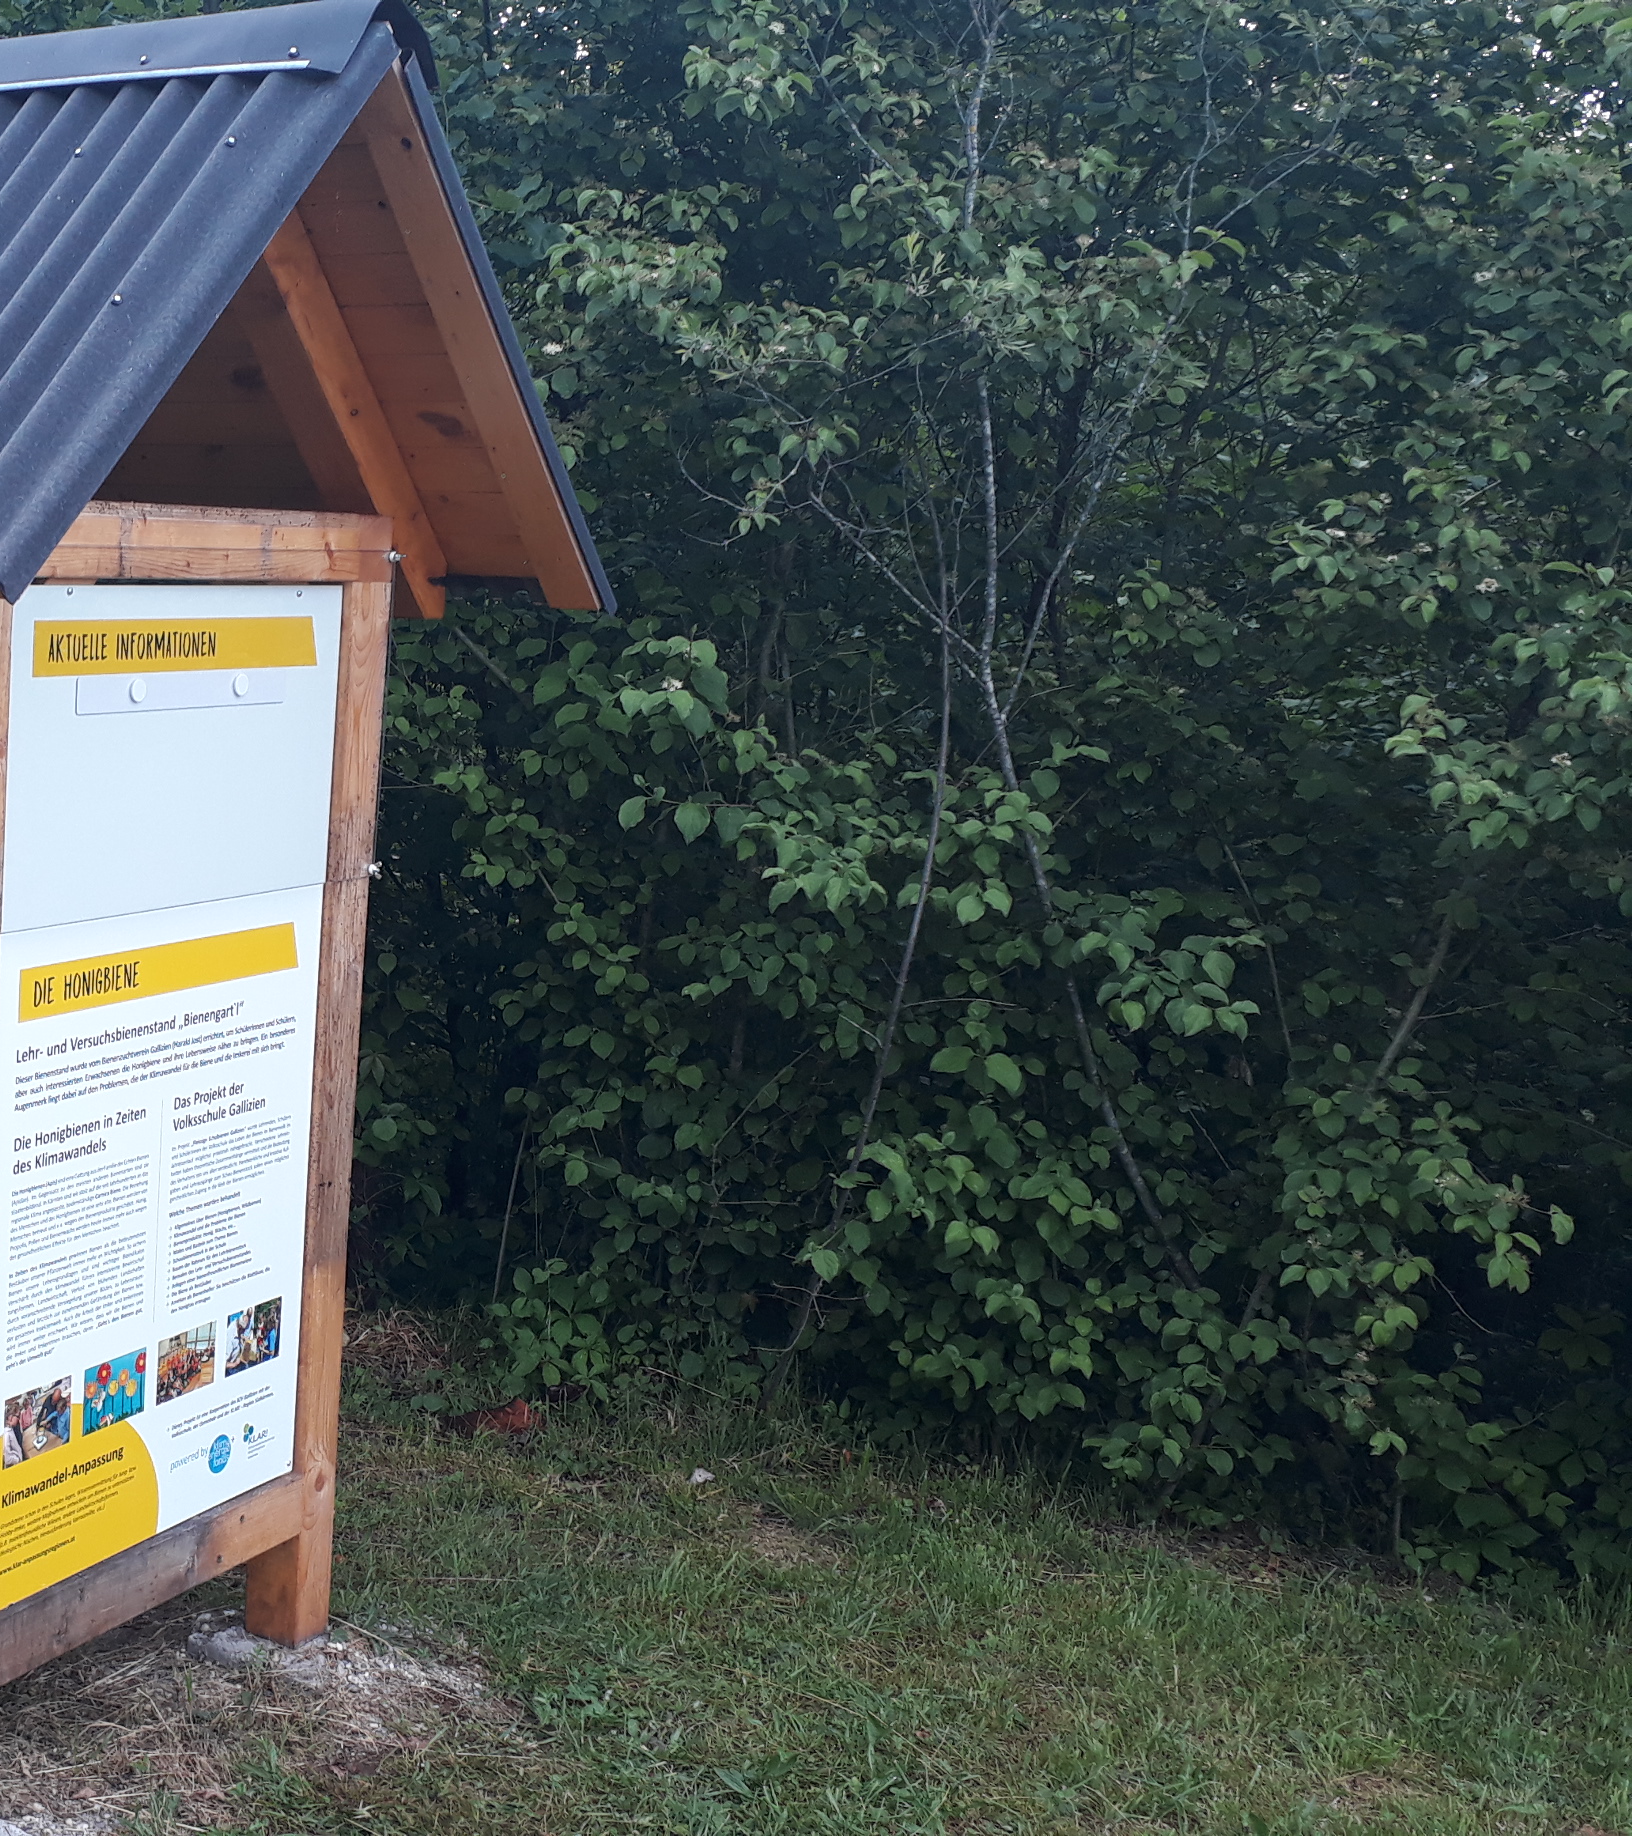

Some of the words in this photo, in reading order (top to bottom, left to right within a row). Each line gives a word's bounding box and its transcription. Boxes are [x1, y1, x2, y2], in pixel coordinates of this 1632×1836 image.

[47, 632, 108, 664] AKTUELLE
[116, 631, 217, 660] INFORMATIONEN
[33, 976, 55, 1007] DIE
[63, 960, 140, 1000] HONIGBIENE
[16, 1045, 43, 1063] Lehr-
[46, 1038, 67, 1056] und
[70, 1014, 176, 1051] Versuchsbienenstand
[172, 1105, 226, 1131] Volksschule
[228, 1097, 265, 1116] Gallizien
[173, 1096, 191, 1110] Das
[193, 1085, 226, 1105] Projekt
[228, 1082, 244, 1096] der
[13, 1135, 31, 1152] Die
[34, 1119, 100, 1147] Honigbienen
[103, 1114, 112, 1128] in
[115, 1108, 146, 1125] Zeiten
[12, 1159, 31, 1175] des
[34, 1137, 106, 1169] Klimawandels
[200, 1446, 208, 1458] by
[1, 1446, 124, 1508] Klimawandel-Anpassung
